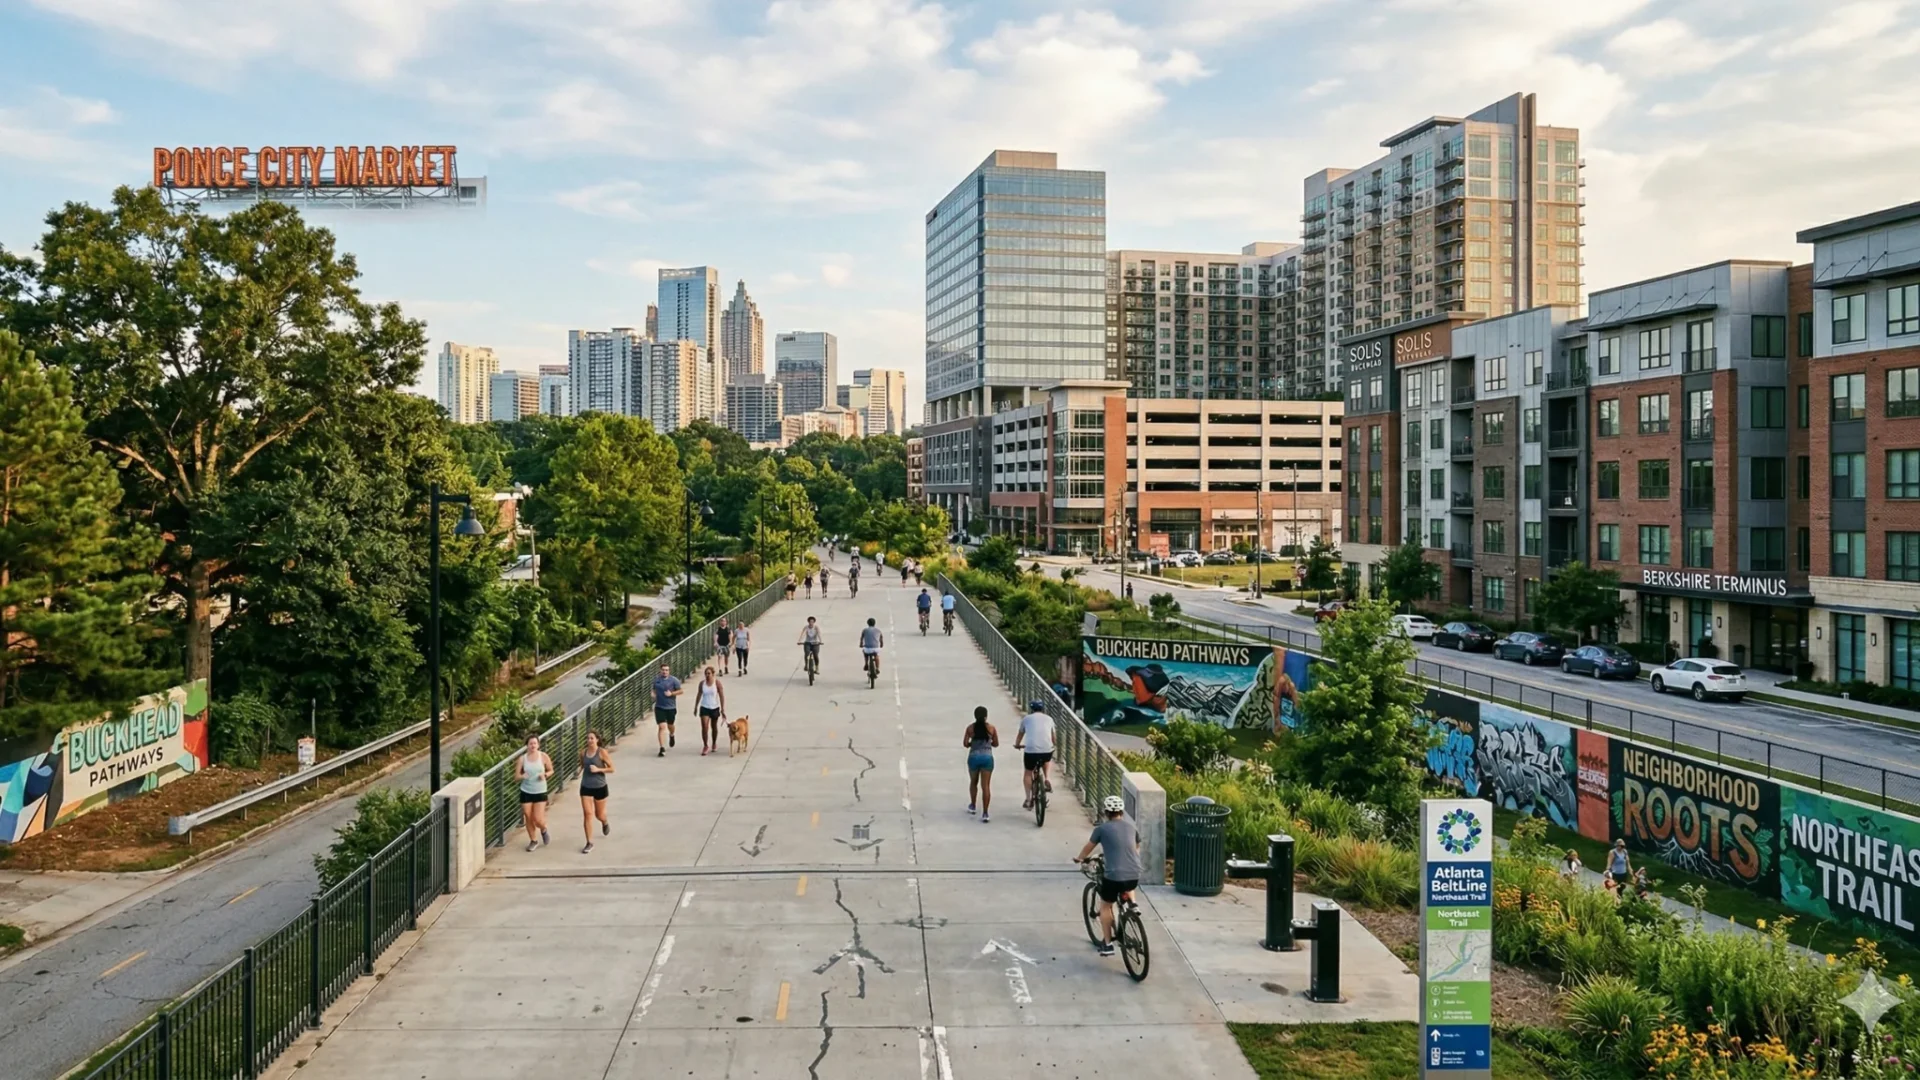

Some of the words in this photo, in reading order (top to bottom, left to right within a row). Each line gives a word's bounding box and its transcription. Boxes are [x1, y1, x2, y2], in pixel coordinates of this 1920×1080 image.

[154, 147, 249, 187] PONCE
[259, 146, 325, 187] CITY
[334, 145, 457, 187] MARKET
[1350, 341, 1382, 362] SOLIS
[1397, 331, 1432, 354] SOLIS
[1643, 569, 1711, 590] BERKSHIRE
[1715, 575, 1787, 596] TERMINUS
[1096, 639, 1168, 660] BUCKHEAD
[1173, 644, 1250, 666] PATHWAYS
[69, 700, 180, 774] BUCKHEAD
[89, 746, 164, 787] PATHWAYS
[1623, 747, 1760, 812] NEIGHBORHOOD
[1624, 777, 1760, 879] ROOTS
[1431, 879, 1487, 891] BeltLine
[1434, 866, 1484, 878] Atlanta
[1816, 859, 1915, 932] TRAIL
